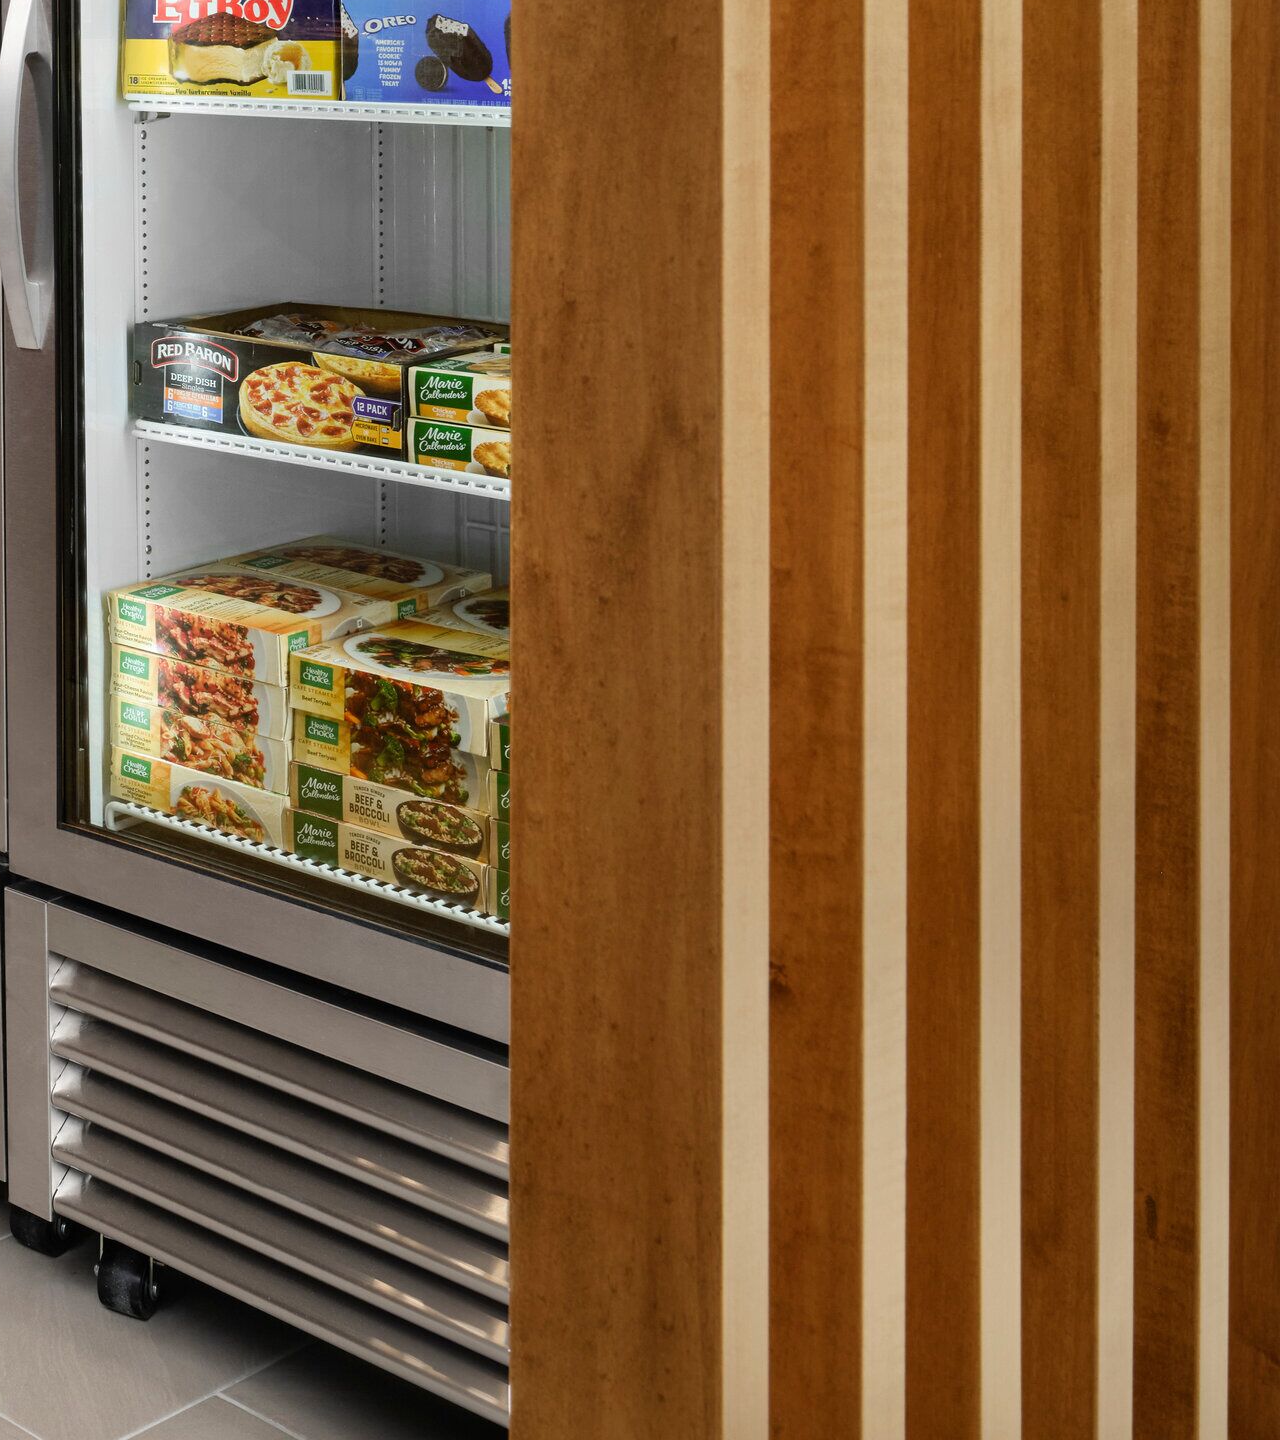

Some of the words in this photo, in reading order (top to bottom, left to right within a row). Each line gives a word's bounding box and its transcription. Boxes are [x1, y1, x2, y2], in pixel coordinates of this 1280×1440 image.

[364, 15, 417, 34] OREO
[129, 76, 139, 85] 18
[157, 343, 182, 359] RED
[185, 342, 232, 372] BARON
[170, 372, 193, 383] DEEP
[195, 377, 217, 388] DISH
[420, 375, 464, 391] Marie
[419, 389, 467, 401] Callender's
[356, 403, 365, 412] 12
[366, 404, 388, 416] PACK
[419, 427, 463, 442] Marie
[418, 440, 466, 452] Callender's
[302, 671, 330, 685] Choice
[306, 666, 329, 679] Healthy
[307, 725, 335, 740] Choice
[311, 720, 334, 733] Healthy
[301, 776, 338, 793] Marie
[301, 788, 341, 801] Callender's
[355, 793, 374, 807] BEEF
[376, 799, 384, 811] &
[349, 802, 391, 823] BROCCOLI
[296, 823, 333, 839] Marie
[296, 833, 336, 848] Callender's
[350, 840, 369, 854] BEEF
[371, 846, 379, 858] &
[344, 849, 386, 871] BROCCOLI
